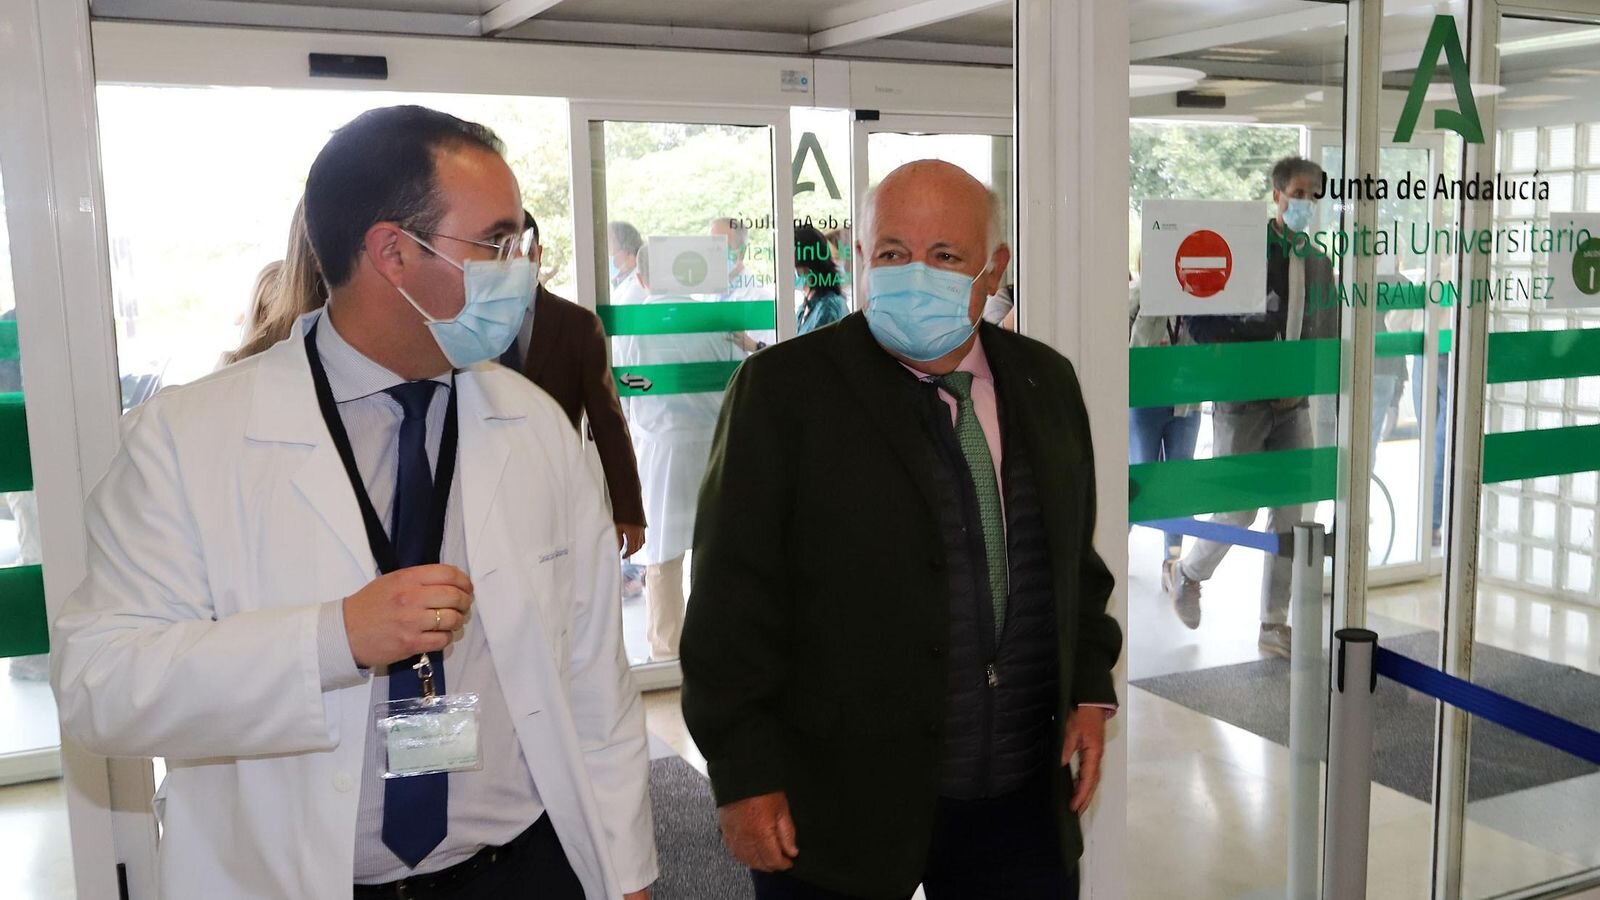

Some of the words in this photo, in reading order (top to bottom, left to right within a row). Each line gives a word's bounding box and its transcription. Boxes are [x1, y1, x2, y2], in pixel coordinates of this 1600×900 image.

[1313, 171, 1389, 201] Junta
[1396, 170, 1427, 200] de
[1433, 168, 1550, 200] Andalucía
[1266, 220, 1398, 267] Hospital
[1411, 220, 1592, 256] Universitario
[1306, 281, 1368, 317] JUAN
[1376, 273, 1462, 307] RAMÓN
[1467, 271, 1555, 309] JIMÉNEZ
